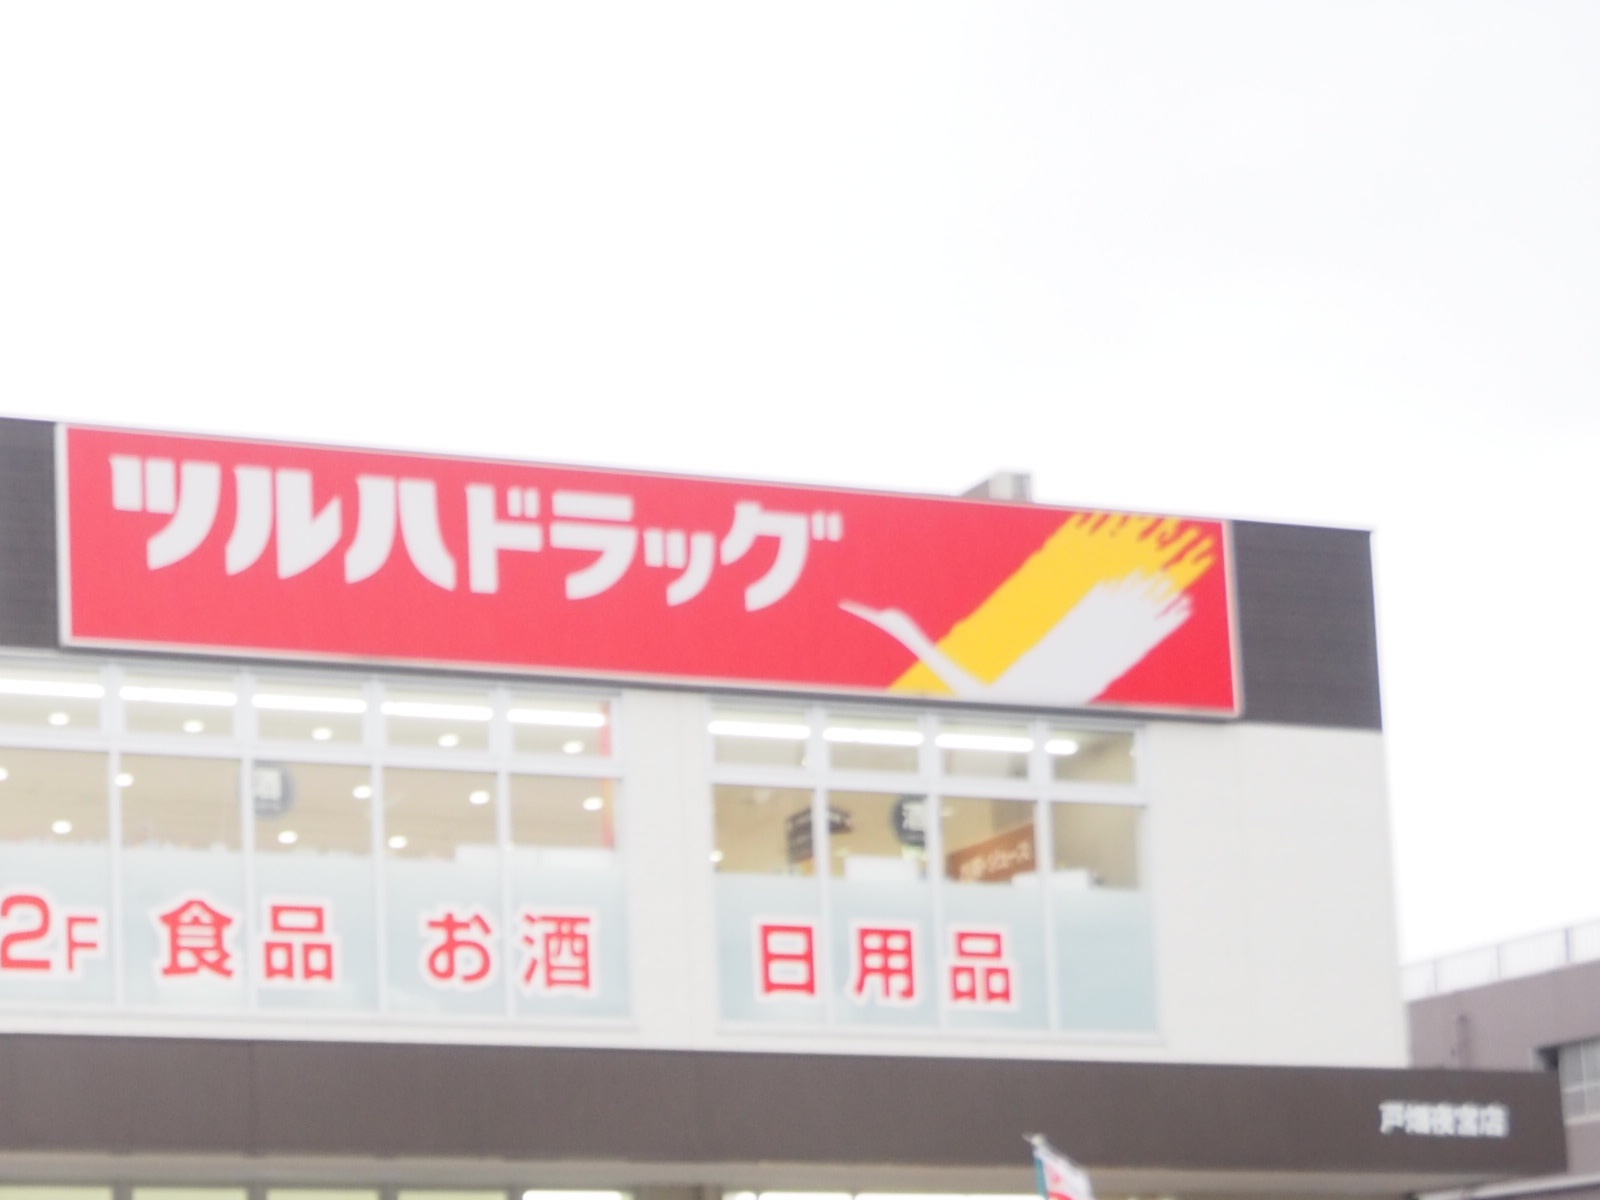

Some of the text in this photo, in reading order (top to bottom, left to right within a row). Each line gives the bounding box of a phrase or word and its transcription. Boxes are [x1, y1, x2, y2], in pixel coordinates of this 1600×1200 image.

[108, 453, 843, 613] ツルハドラッグ
[0, 893, 1012, 1004] 2F 食品 お酒 日用品
